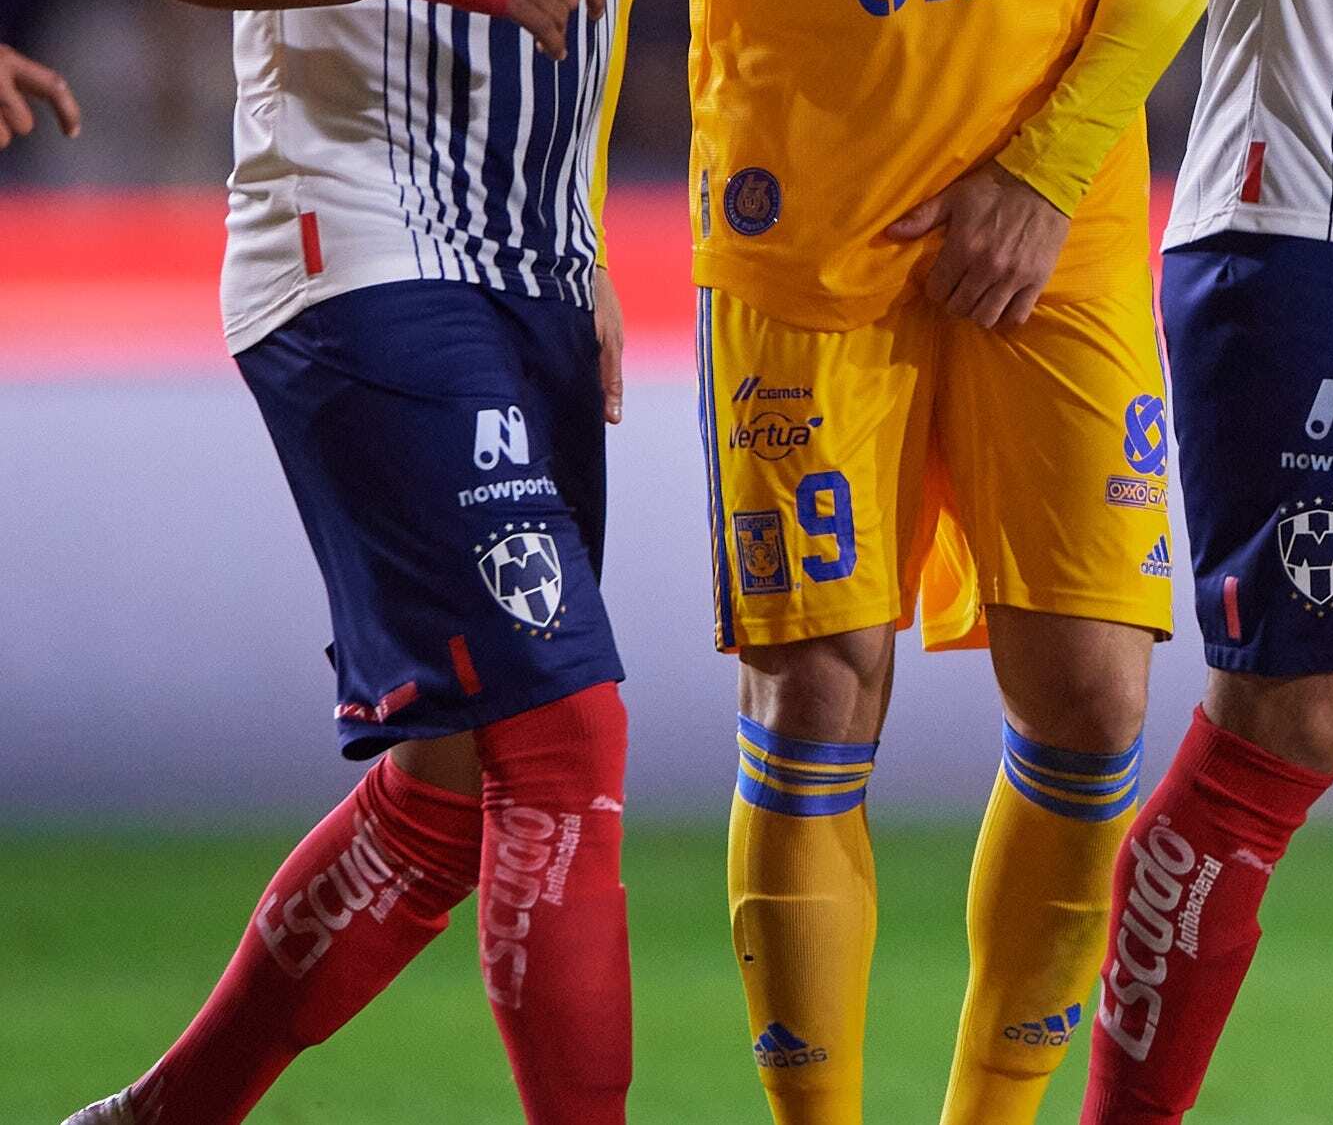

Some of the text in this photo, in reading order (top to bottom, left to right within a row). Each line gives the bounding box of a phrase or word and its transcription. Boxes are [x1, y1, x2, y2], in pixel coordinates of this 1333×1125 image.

[729, 421, 811, 450] Vertua
[458, 475, 558, 507] nowports
[796, 471, 857, 583] 9
[1175, 853, 1224, 959] Antibacterial
